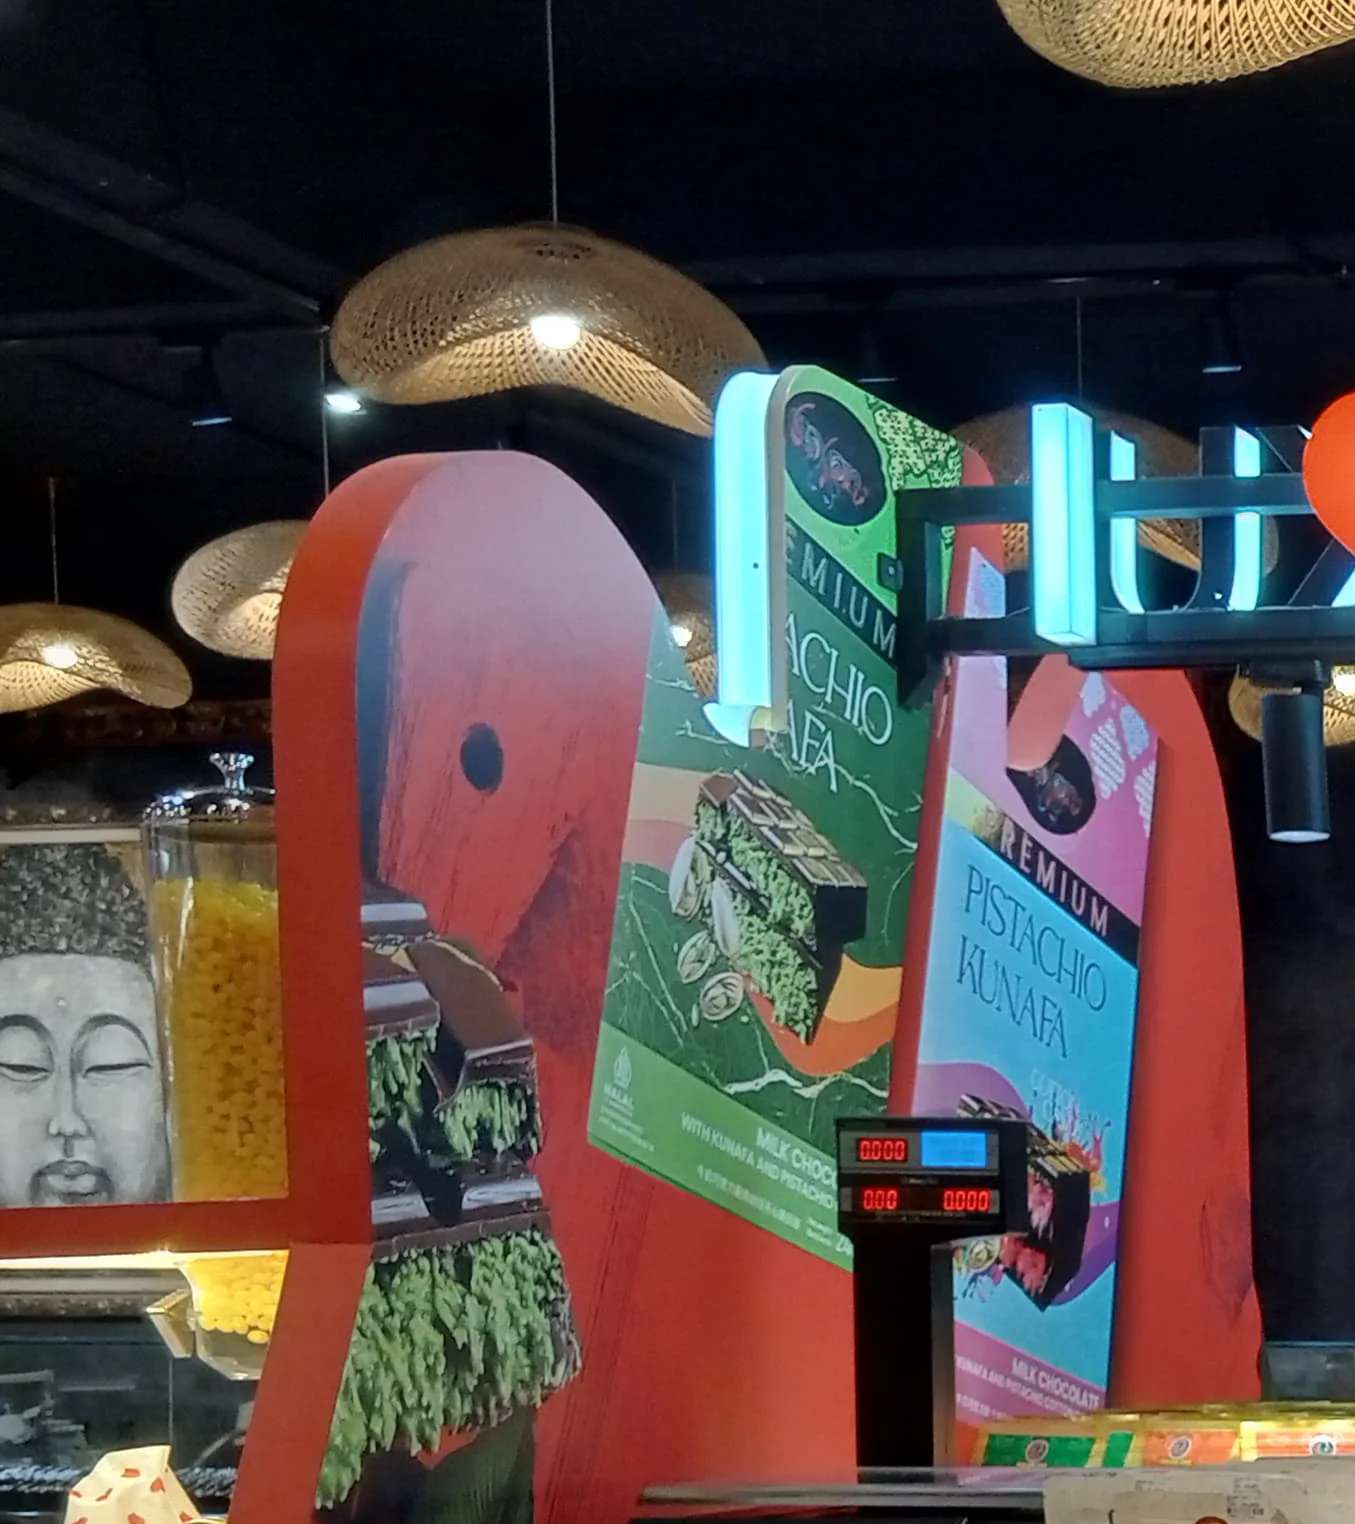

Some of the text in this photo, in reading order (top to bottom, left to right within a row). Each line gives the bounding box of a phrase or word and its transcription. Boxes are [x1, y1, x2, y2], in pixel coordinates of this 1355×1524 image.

[984, 803, 1110, 937] PREMIUM
[957, 934, 1068, 1058] KUNAFA
[964, 864, 1107, 1011] PISTACHIO
